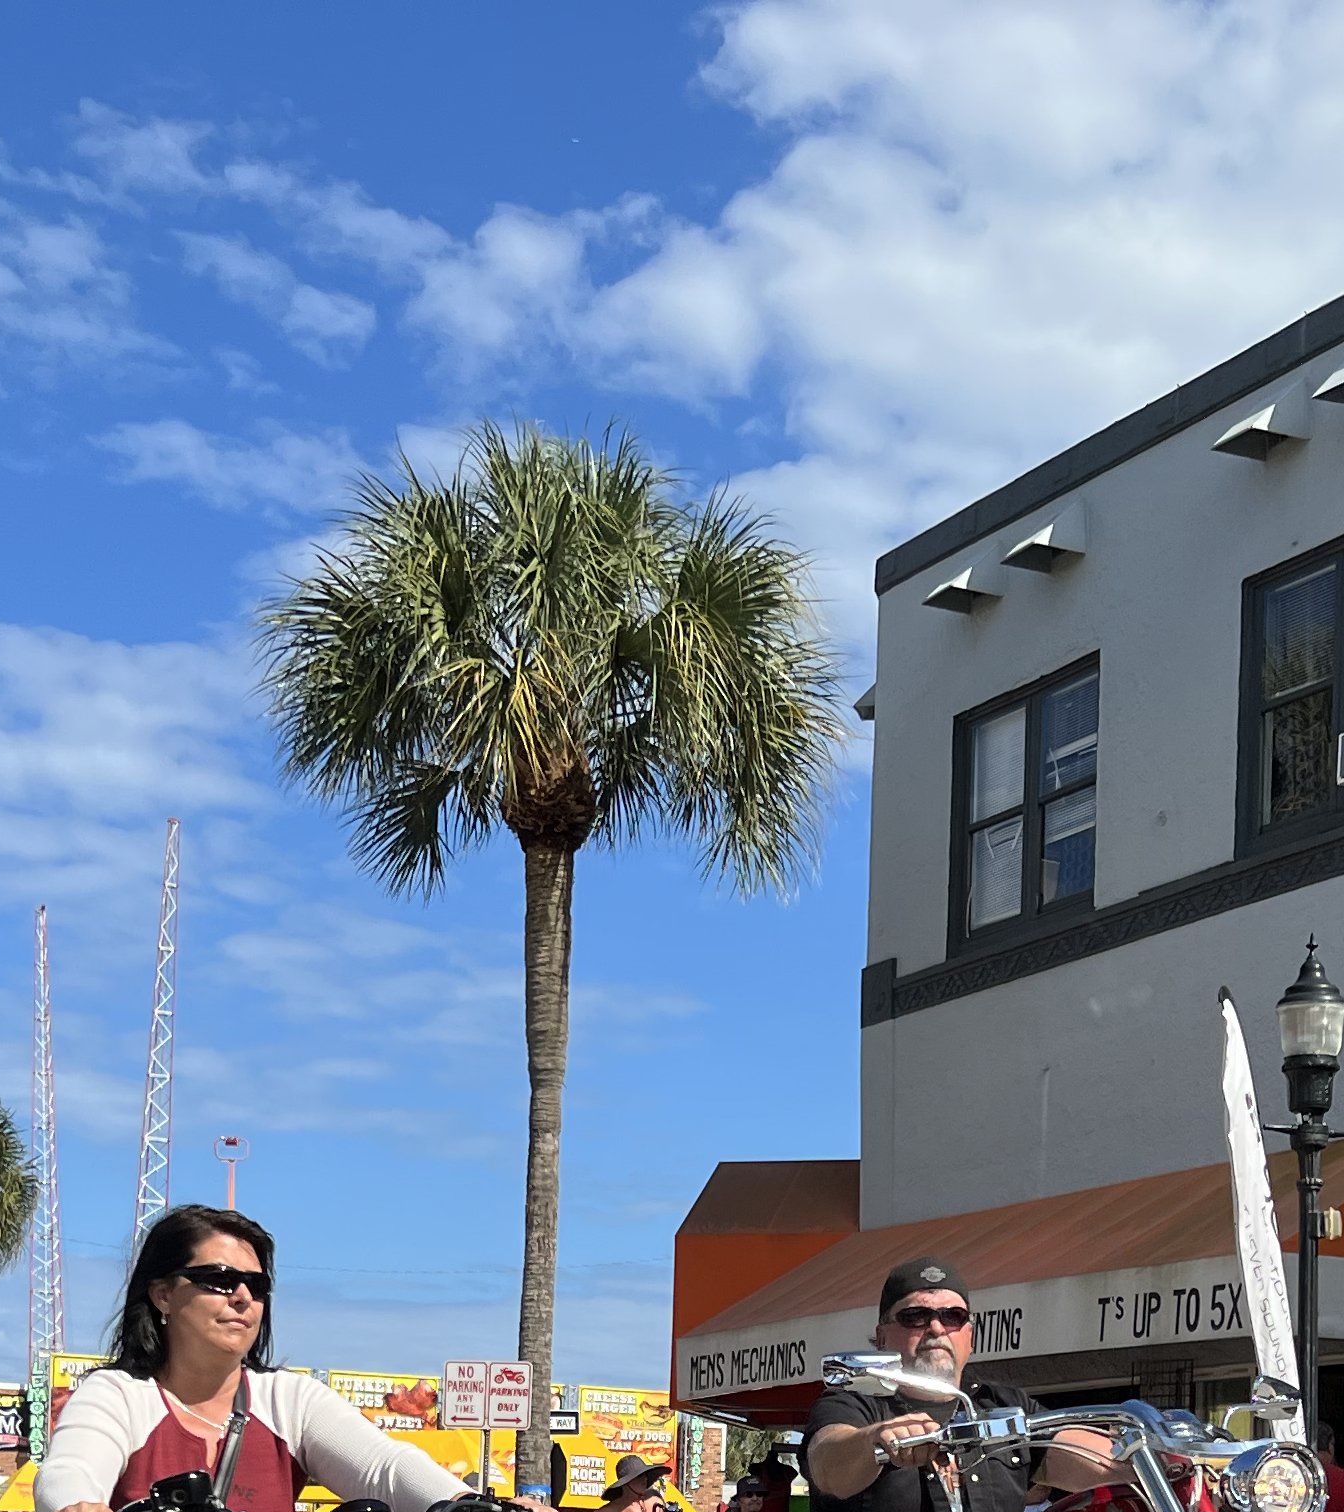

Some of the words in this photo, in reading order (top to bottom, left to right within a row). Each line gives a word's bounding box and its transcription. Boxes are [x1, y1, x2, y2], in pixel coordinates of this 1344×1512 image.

[1133, 1291, 1161, 1338] UP
[1173, 1287, 1200, 1335] TO
[1210, 1282, 1243, 1331] 5X
[730, 1340, 806, 1387] MECHANICS
[458, 1366, 474, 1378] NO
[336, 1379, 393, 1393] TURKEY
[447, 1380, 484, 1393] PARKING
[490, 1388, 528, 1397] PARKING
[585, 1392, 635, 1404] CHEESE
[456, 1395, 473, 1403] ANY
[456, 1404, 474, 1413] TIME
[497, 1403, 519, 1412] ONLY
[584, 1402, 636, 1415] BURGER
[375, 1416, 424, 1429] SWEET
[556, 1418, 573, 1428] WAY
[620, 1430, 643, 1440] HOT
[645, 1431, 672, 1442] DOGS
[570, 1455, 605, 1467] COUNTRY
[570, 1468, 605, 1482] ROCK
